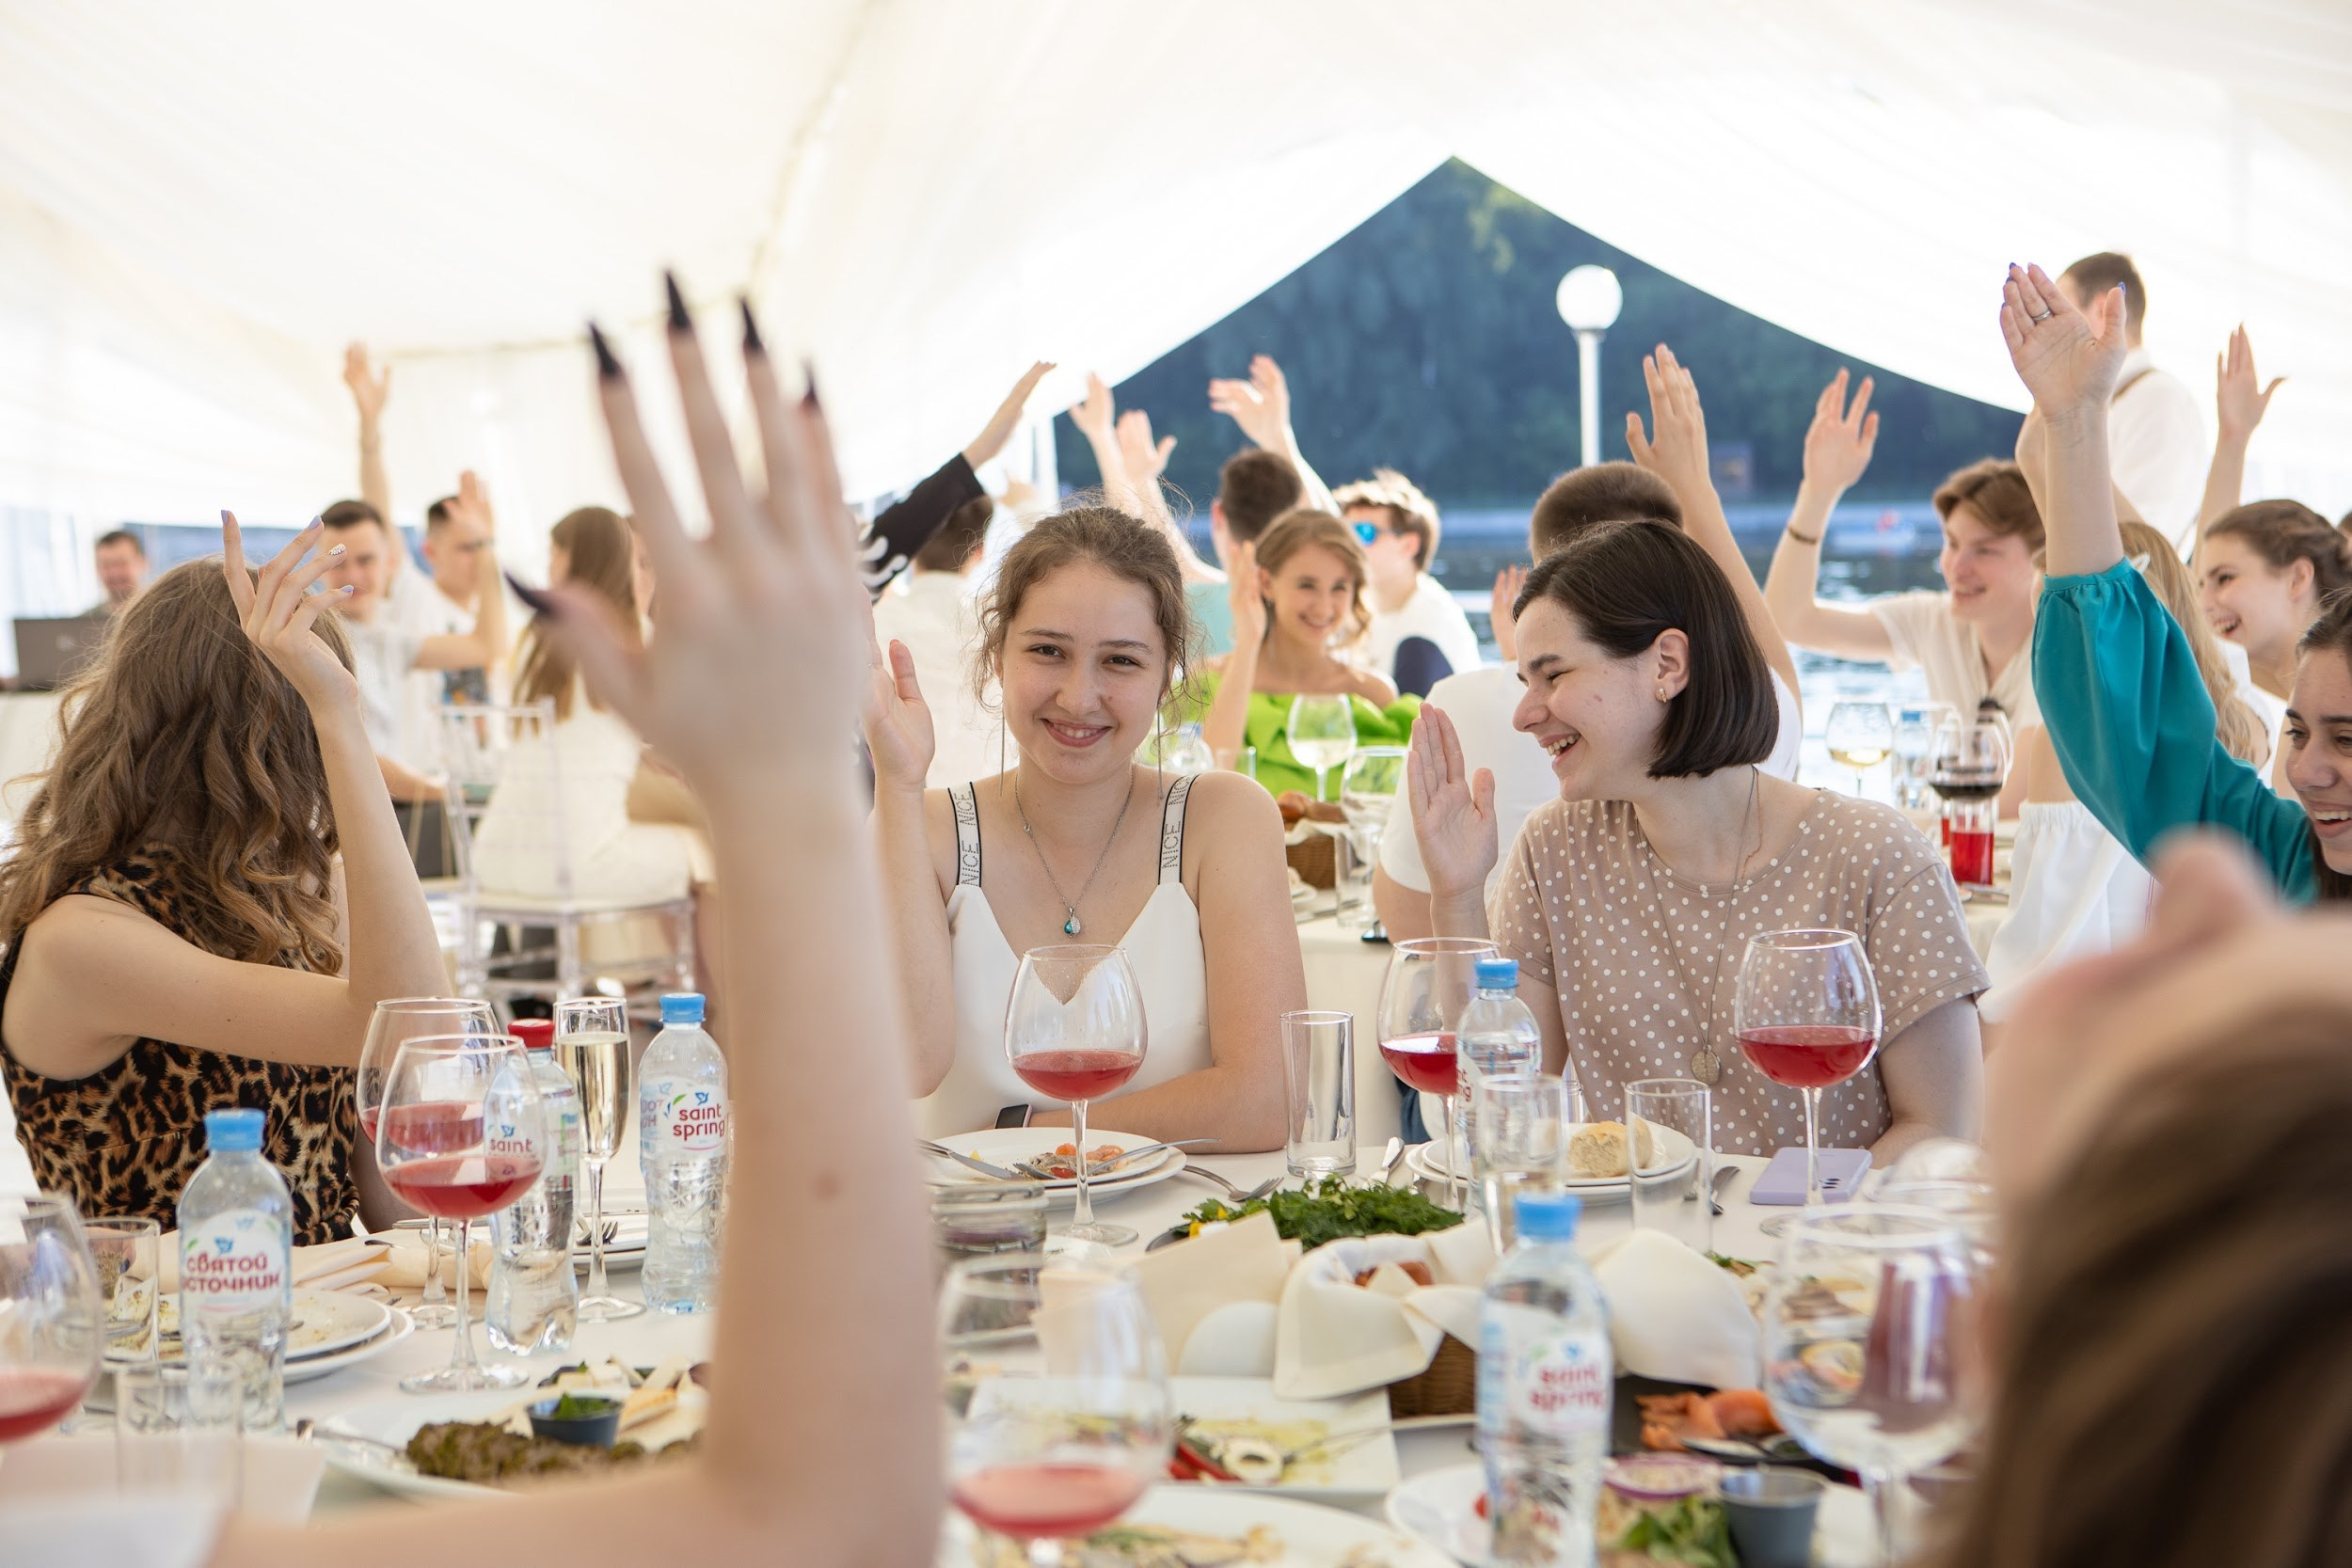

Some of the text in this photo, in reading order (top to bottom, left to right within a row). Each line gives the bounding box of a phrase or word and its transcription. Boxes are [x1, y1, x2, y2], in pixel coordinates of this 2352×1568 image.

[953, 790, 980, 886] NICE NICE
[1162, 820, 1181, 868] NICE
[678, 1103, 722, 1121] saint
[673, 1120, 725, 1141] spring
[490, 1138, 532, 1153] saint
